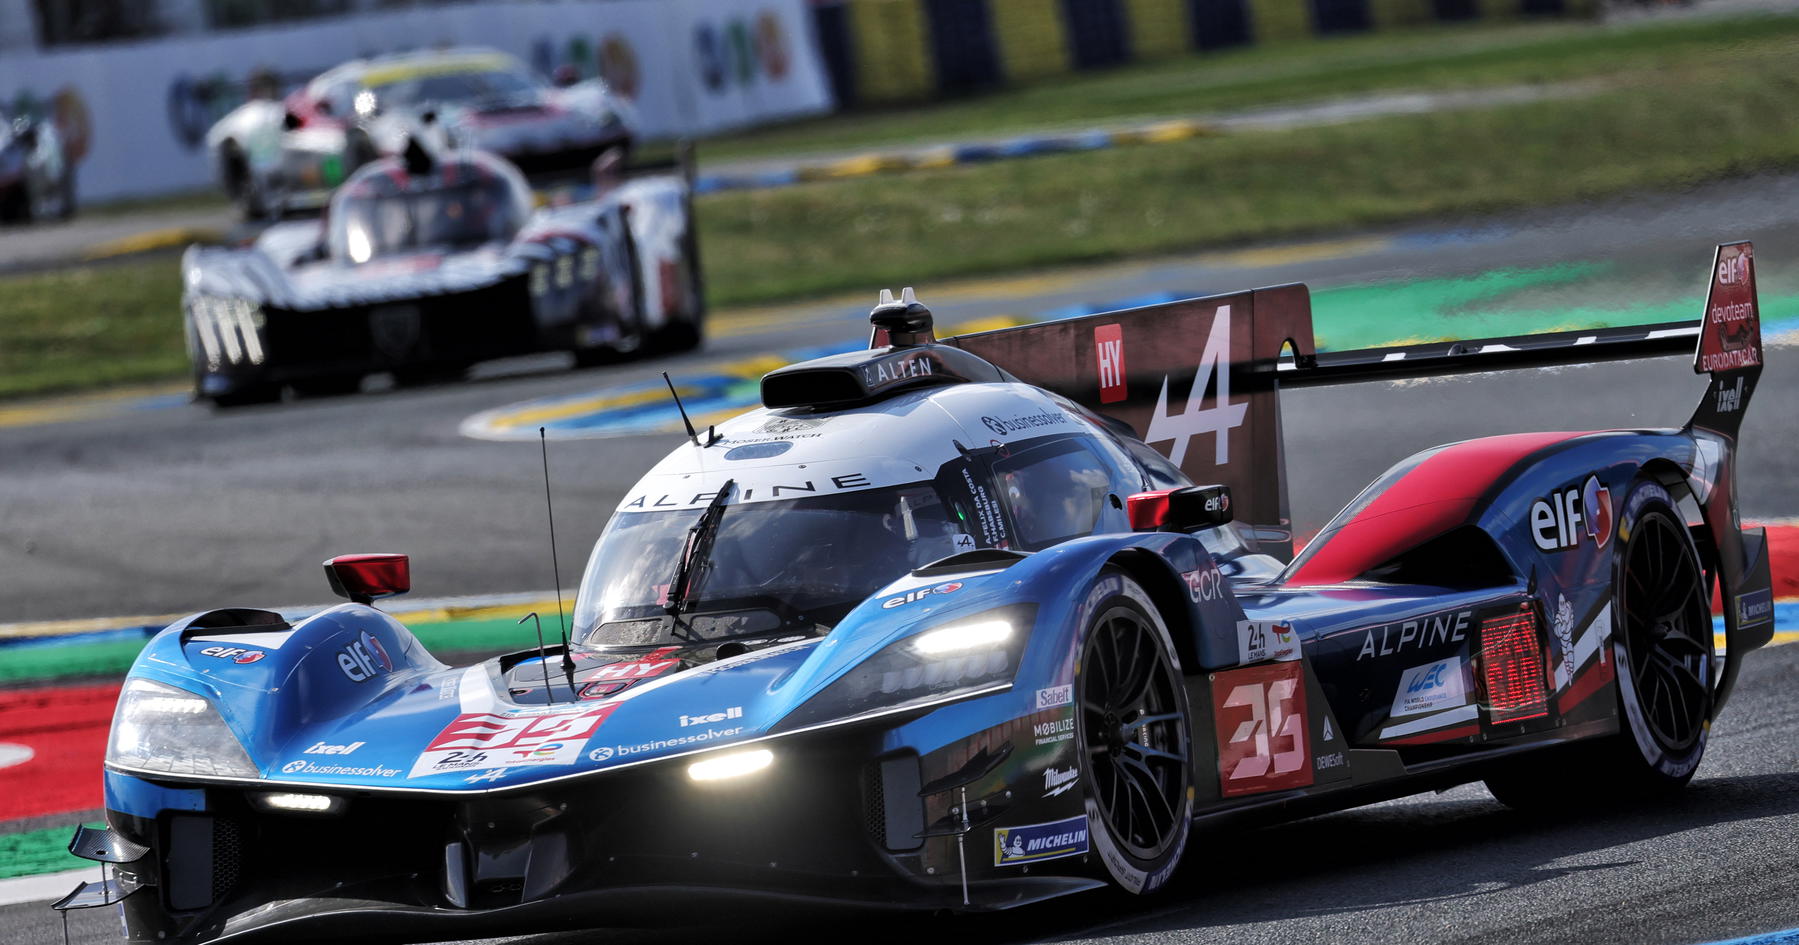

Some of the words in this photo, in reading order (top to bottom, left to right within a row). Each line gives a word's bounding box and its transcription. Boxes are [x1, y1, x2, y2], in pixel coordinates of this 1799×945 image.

[1718, 258, 1737, 284] elf
[1712, 302, 1753, 324] devoteam
[878, 357, 932, 382] ALTEN
[1098, 339, 1121, 389] HY
[1702, 347, 1759, 371] EURODATACAR
[1716, 376, 1744, 413] ixell
[995, 408, 1067, 431] businessolver
[962, 468, 977, 495] COSTA
[974, 495, 982, 509] DA
[1205, 497, 1220, 512] elf
[991, 500, 1006, 538] C.MILESI
[1531, 489, 1581, 550] elf
[883, 588, 931, 609] elf
[1189, 570, 1223, 603] GCR
[1356, 610, 1472, 661] ALPINE
[201, 646, 242, 659] elf
[337, 641, 376, 682] elf
[592, 660, 673, 679] HY
[1407, 663, 1448, 693] WEC
[1040, 687, 1069, 706] Sabelt
[432, 702, 619, 749] 35
[680, 706, 742, 727] ixell
[617, 726, 744, 756] businessolver
[1223, 678, 1304, 780] 35
[303, 741, 367, 755] ixell
[303, 761, 402, 778] businessolver
[1317, 753, 1344, 770] DEWESoft
[1027, 830, 1087, 851] MICHELIN
